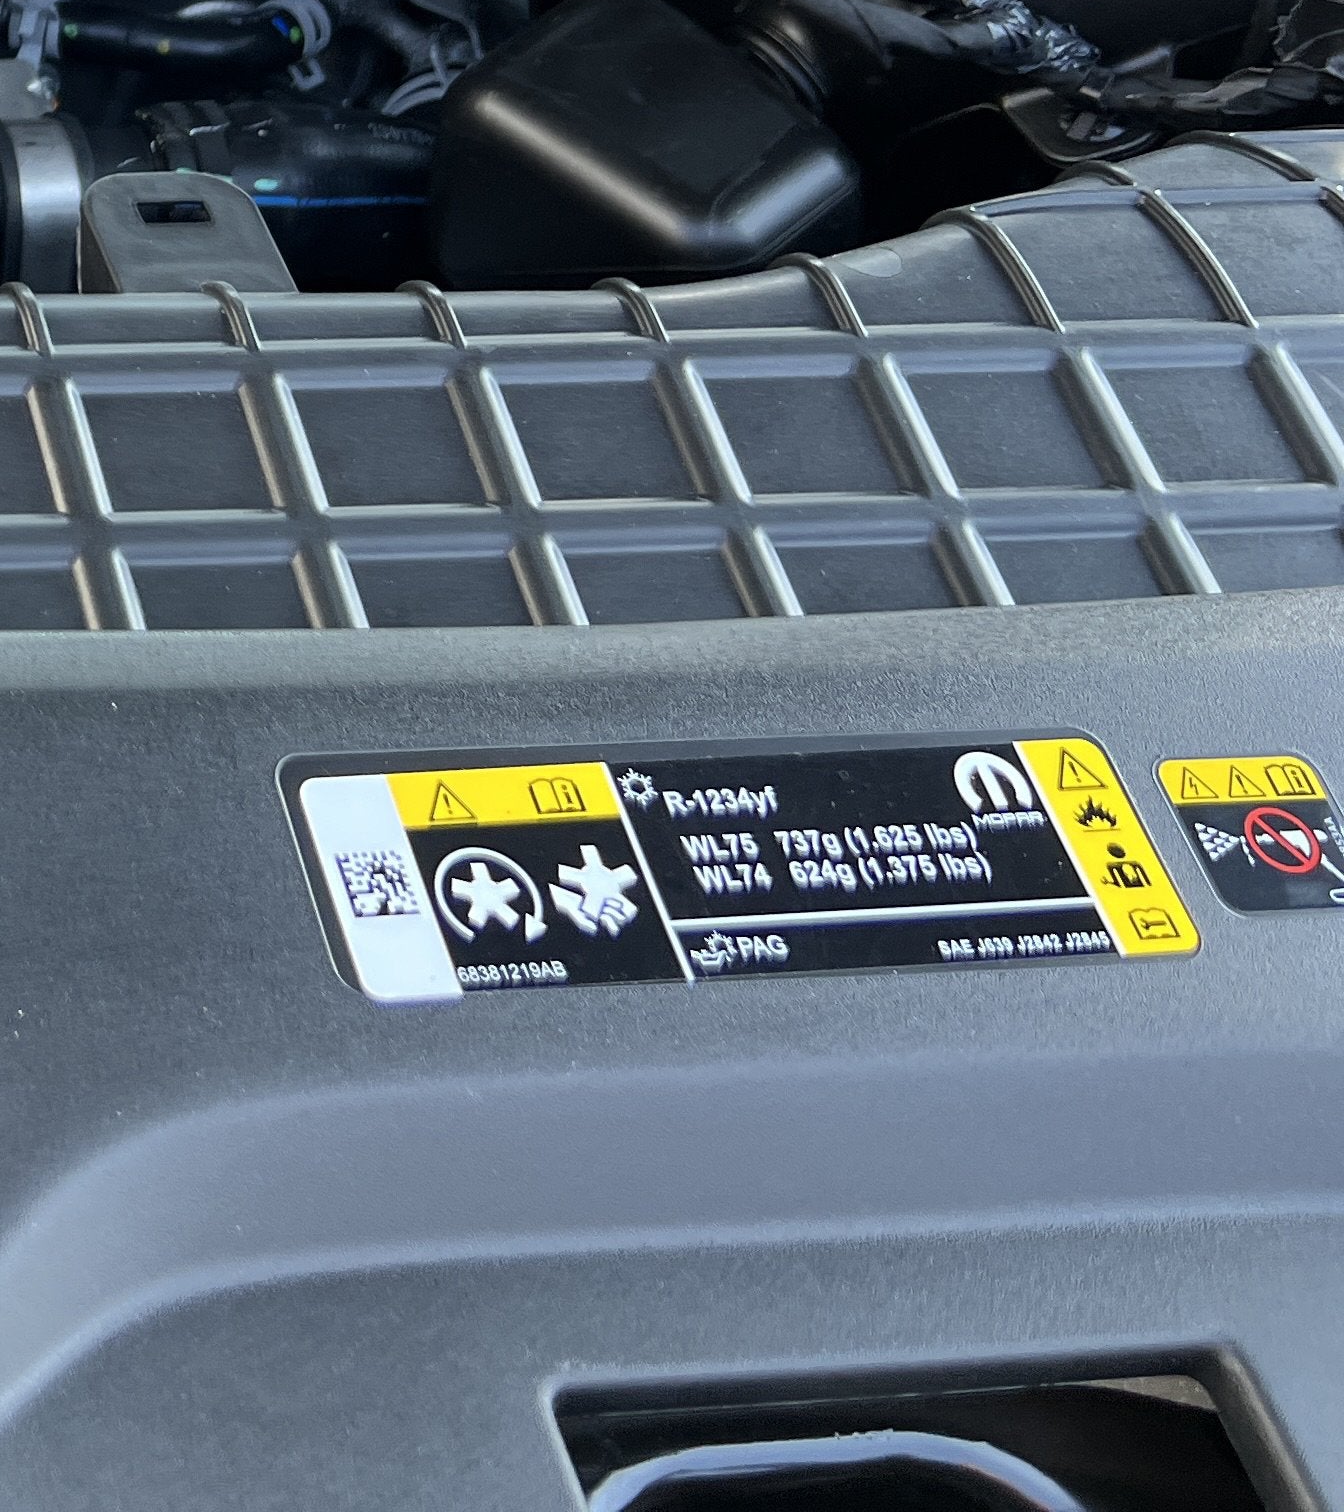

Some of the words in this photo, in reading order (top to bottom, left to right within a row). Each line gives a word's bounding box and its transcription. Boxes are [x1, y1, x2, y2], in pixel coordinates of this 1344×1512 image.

[662, 786, 778, 818] R-1234yf
[971, 811, 1045, 830] MOPAR
[679, 832, 760, 863] WL75
[773, 829, 843, 859] 737g
[844, 825, 923, 857] (1.625
[923, 821, 979, 853] lbs)
[692, 862, 773, 894] WL74
[788, 859, 857, 892] 624g
[858, 855, 937, 889] (1.375
[937, 851, 993, 884] lbs)
[735, 934, 789, 962] PAG
[937, 938, 975, 960] SAE
[456, 960, 568, 985] 68381219AB
